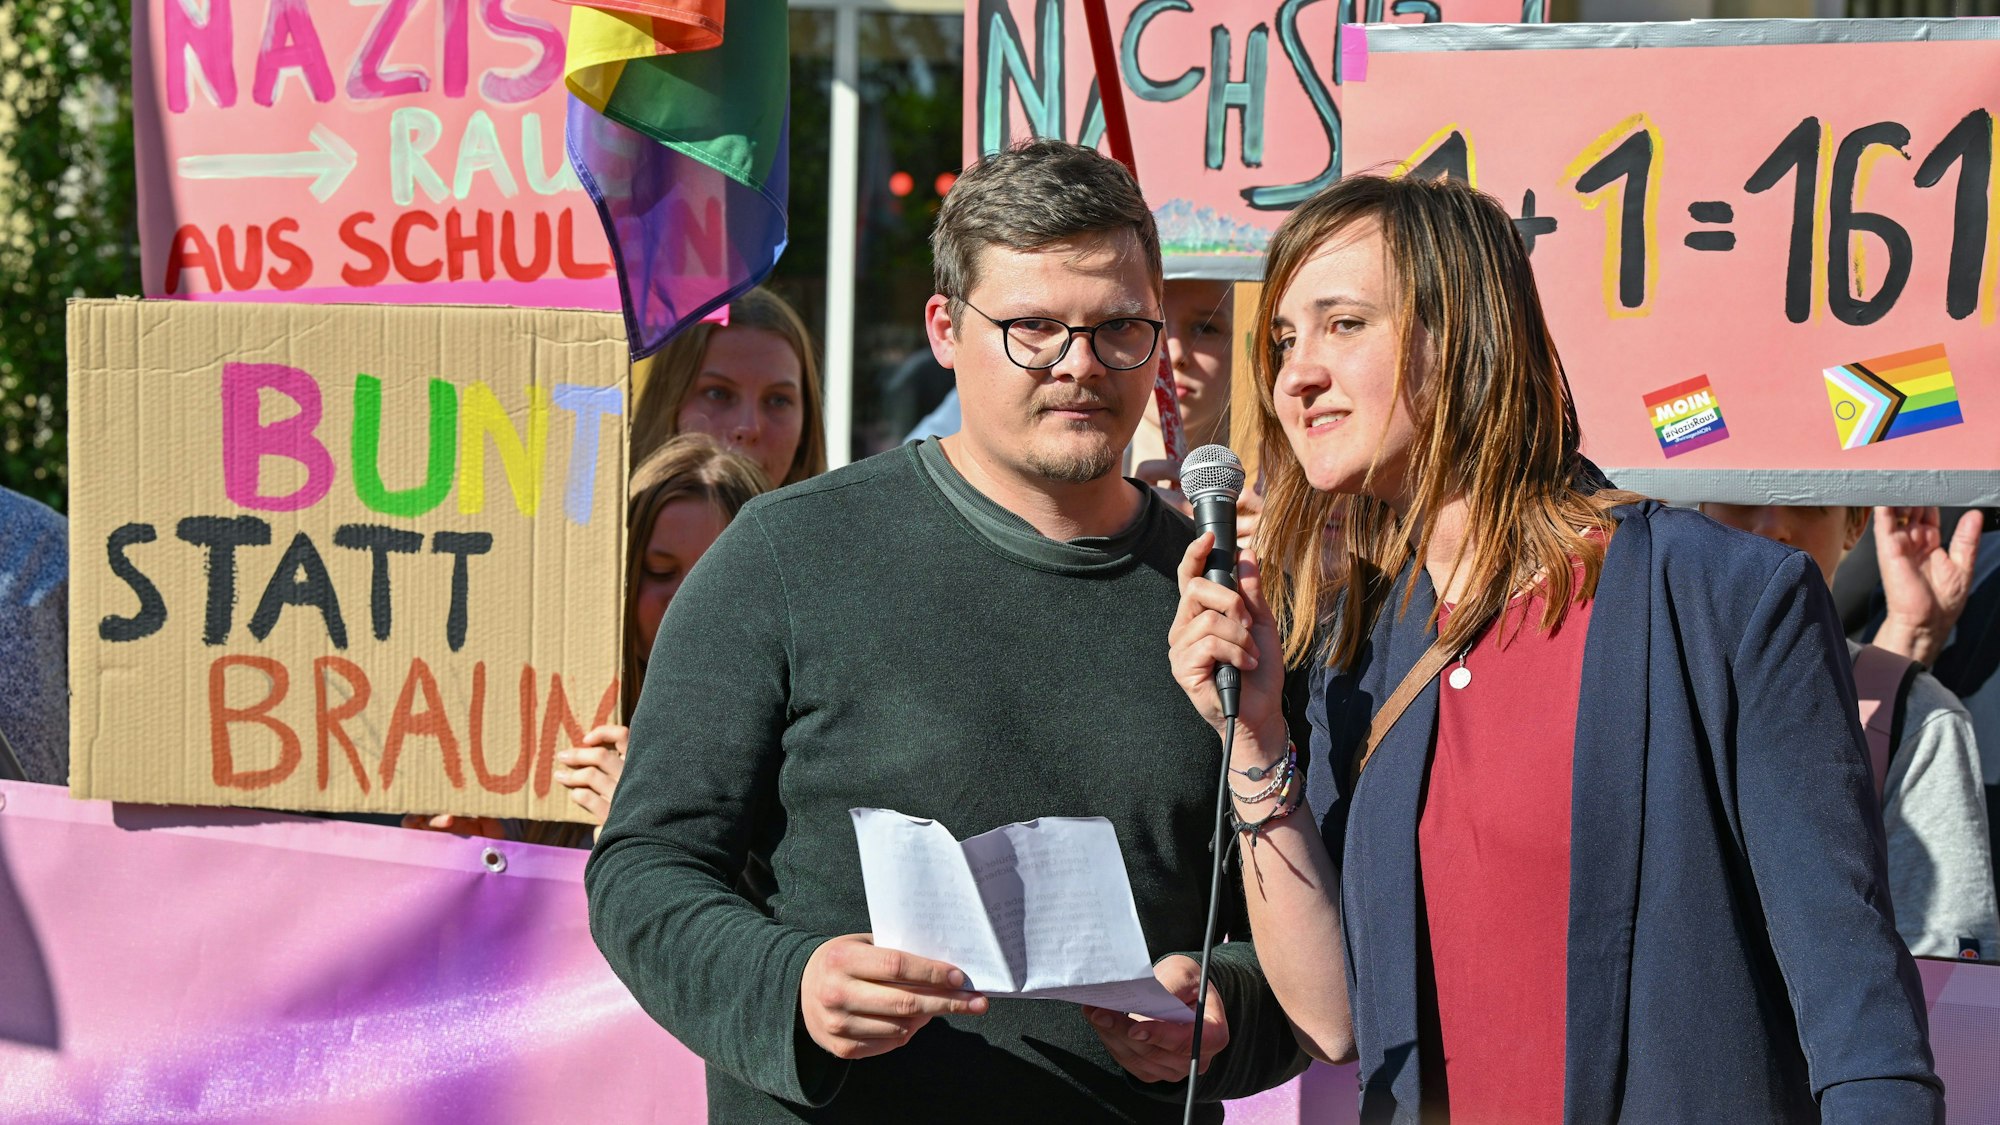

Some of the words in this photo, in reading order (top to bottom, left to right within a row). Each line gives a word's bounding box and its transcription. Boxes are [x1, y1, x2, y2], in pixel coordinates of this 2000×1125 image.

[165, 0, 567, 113] NAZIS
[164, 217, 313, 295] AUS
[1744, 108, 1996, 326] 161
[221, 361, 623, 526] BUNT
[1655, 390, 1711, 423] MOIN
[1665, 412, 1715, 439] #NazisRaus
[98, 514, 494, 653] STATT
[208, 654, 620, 798] BRAUN
